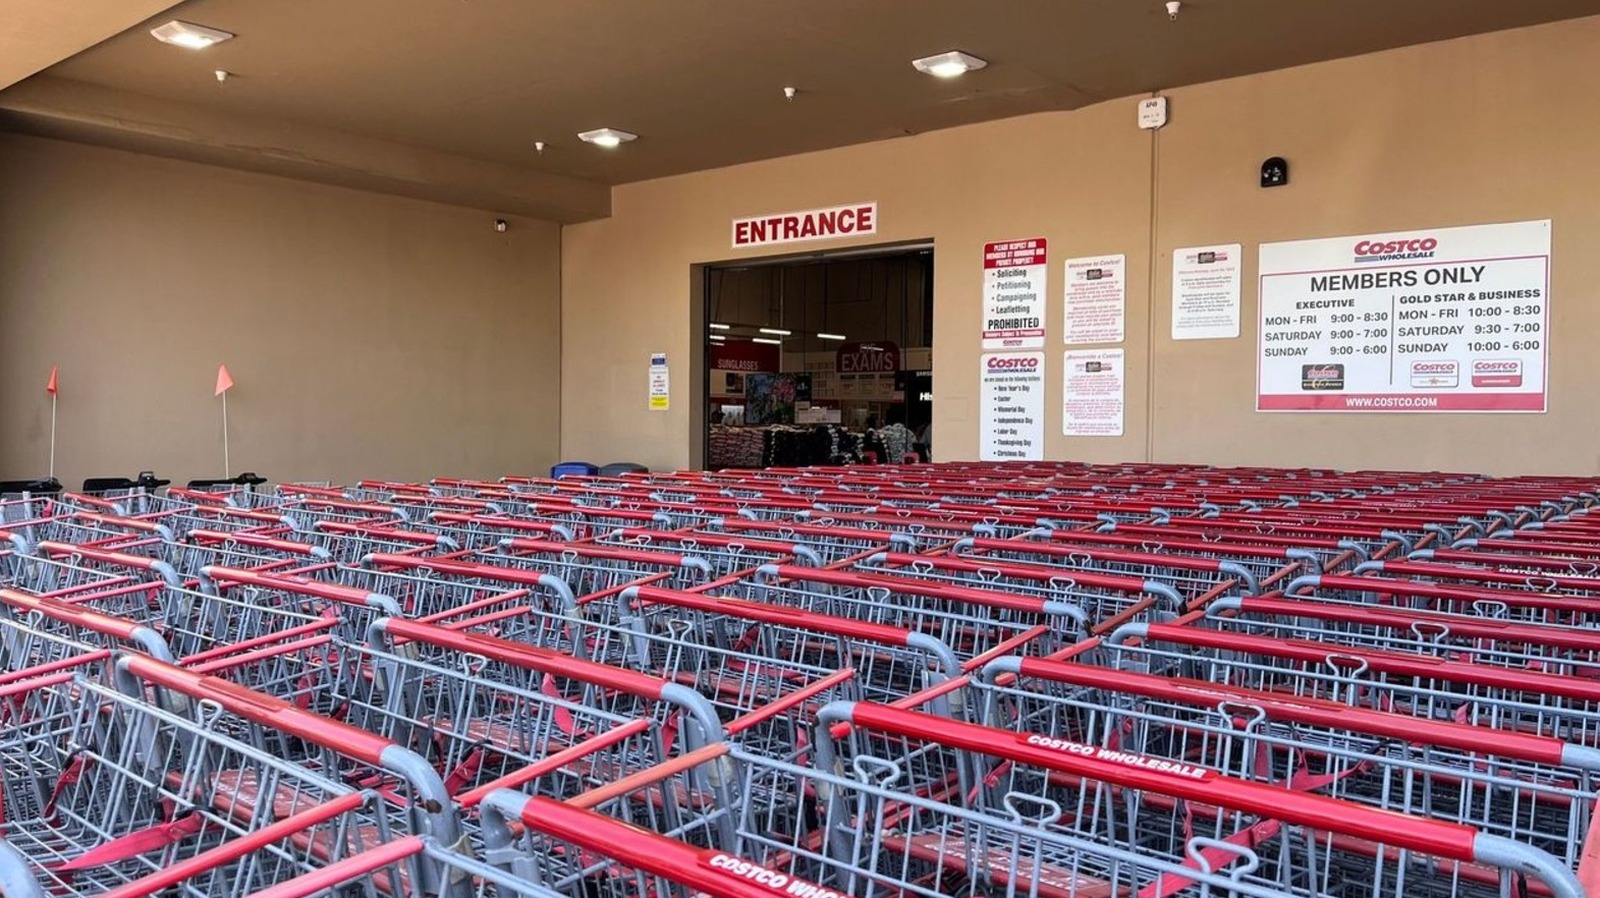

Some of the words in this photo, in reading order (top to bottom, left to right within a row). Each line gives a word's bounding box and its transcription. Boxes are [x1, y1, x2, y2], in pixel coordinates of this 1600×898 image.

[735, 206, 872, 244] ENTRANCE
[1354, 238, 1438, 256] COSTCO
[1378, 251, 1435, 262] WHOLESALE
[997, 268, 1026, 278] Soliciting
[1310, 270, 1418, 292] MEMBERS
[1424, 266, 1486, 286] ONLY
[997, 281, 1031, 290] Petitioning
[996, 292, 1036, 302] Campaigning
[1400, 296, 1432, 304] GOLD
[1434, 293, 1465, 302] STAR
[1468, 292, 1476, 300] &
[1478, 289, 1540, 300] BUSINESS
[996, 304, 1030, 314] Leafletting
[1296, 299, 1355, 310] EXECUTIVE
[1265, 316, 1290, 326] MON
[1300, 315, 1316, 324] FRI
[1330, 314, 1354, 323] 9:00
[1364, 312, 1388, 322] 8:30
[1399, 310, 1428, 320] MON
[1439, 308, 1458, 318] FRI
[1468, 306, 1502, 317] 10:00
[1513, 305, 1540, 315] 8:30
[988, 317, 1040, 330] PROHIBITED
[1398, 325, 1464, 336] SATURDAY
[1474, 324, 1501, 334] 9:30
[1513, 322, 1540, 333] 7:00
[1264, 330, 1322, 341] SATURDAY
[1330, 330, 1354, 339] 9:00
[1364, 328, 1388, 338] 7:00
[1264, 347, 1308, 357] SUNDAY
[1330, 346, 1353, 355] 9:00
[1363, 345, 1387, 354] 6:00
[1398, 343, 1448, 353] SUNDAY
[1468, 342, 1501, 351] 10:00
[1512, 340, 1540, 350] 6:00
[717, 359, 759, 370] SUNGLASSES
[842, 352, 894, 371] EXAMS
[988, 357, 1038, 368] COSTCO
[1474, 362, 1518, 370] COSTCO
[1345, 397, 1437, 407] WWW.COSTCO.COM
[1027, 734, 1094, 755] COSTCO
[1097, 749, 1206, 779] WHOLESALE
[709, 854, 788, 888] COSTCO
